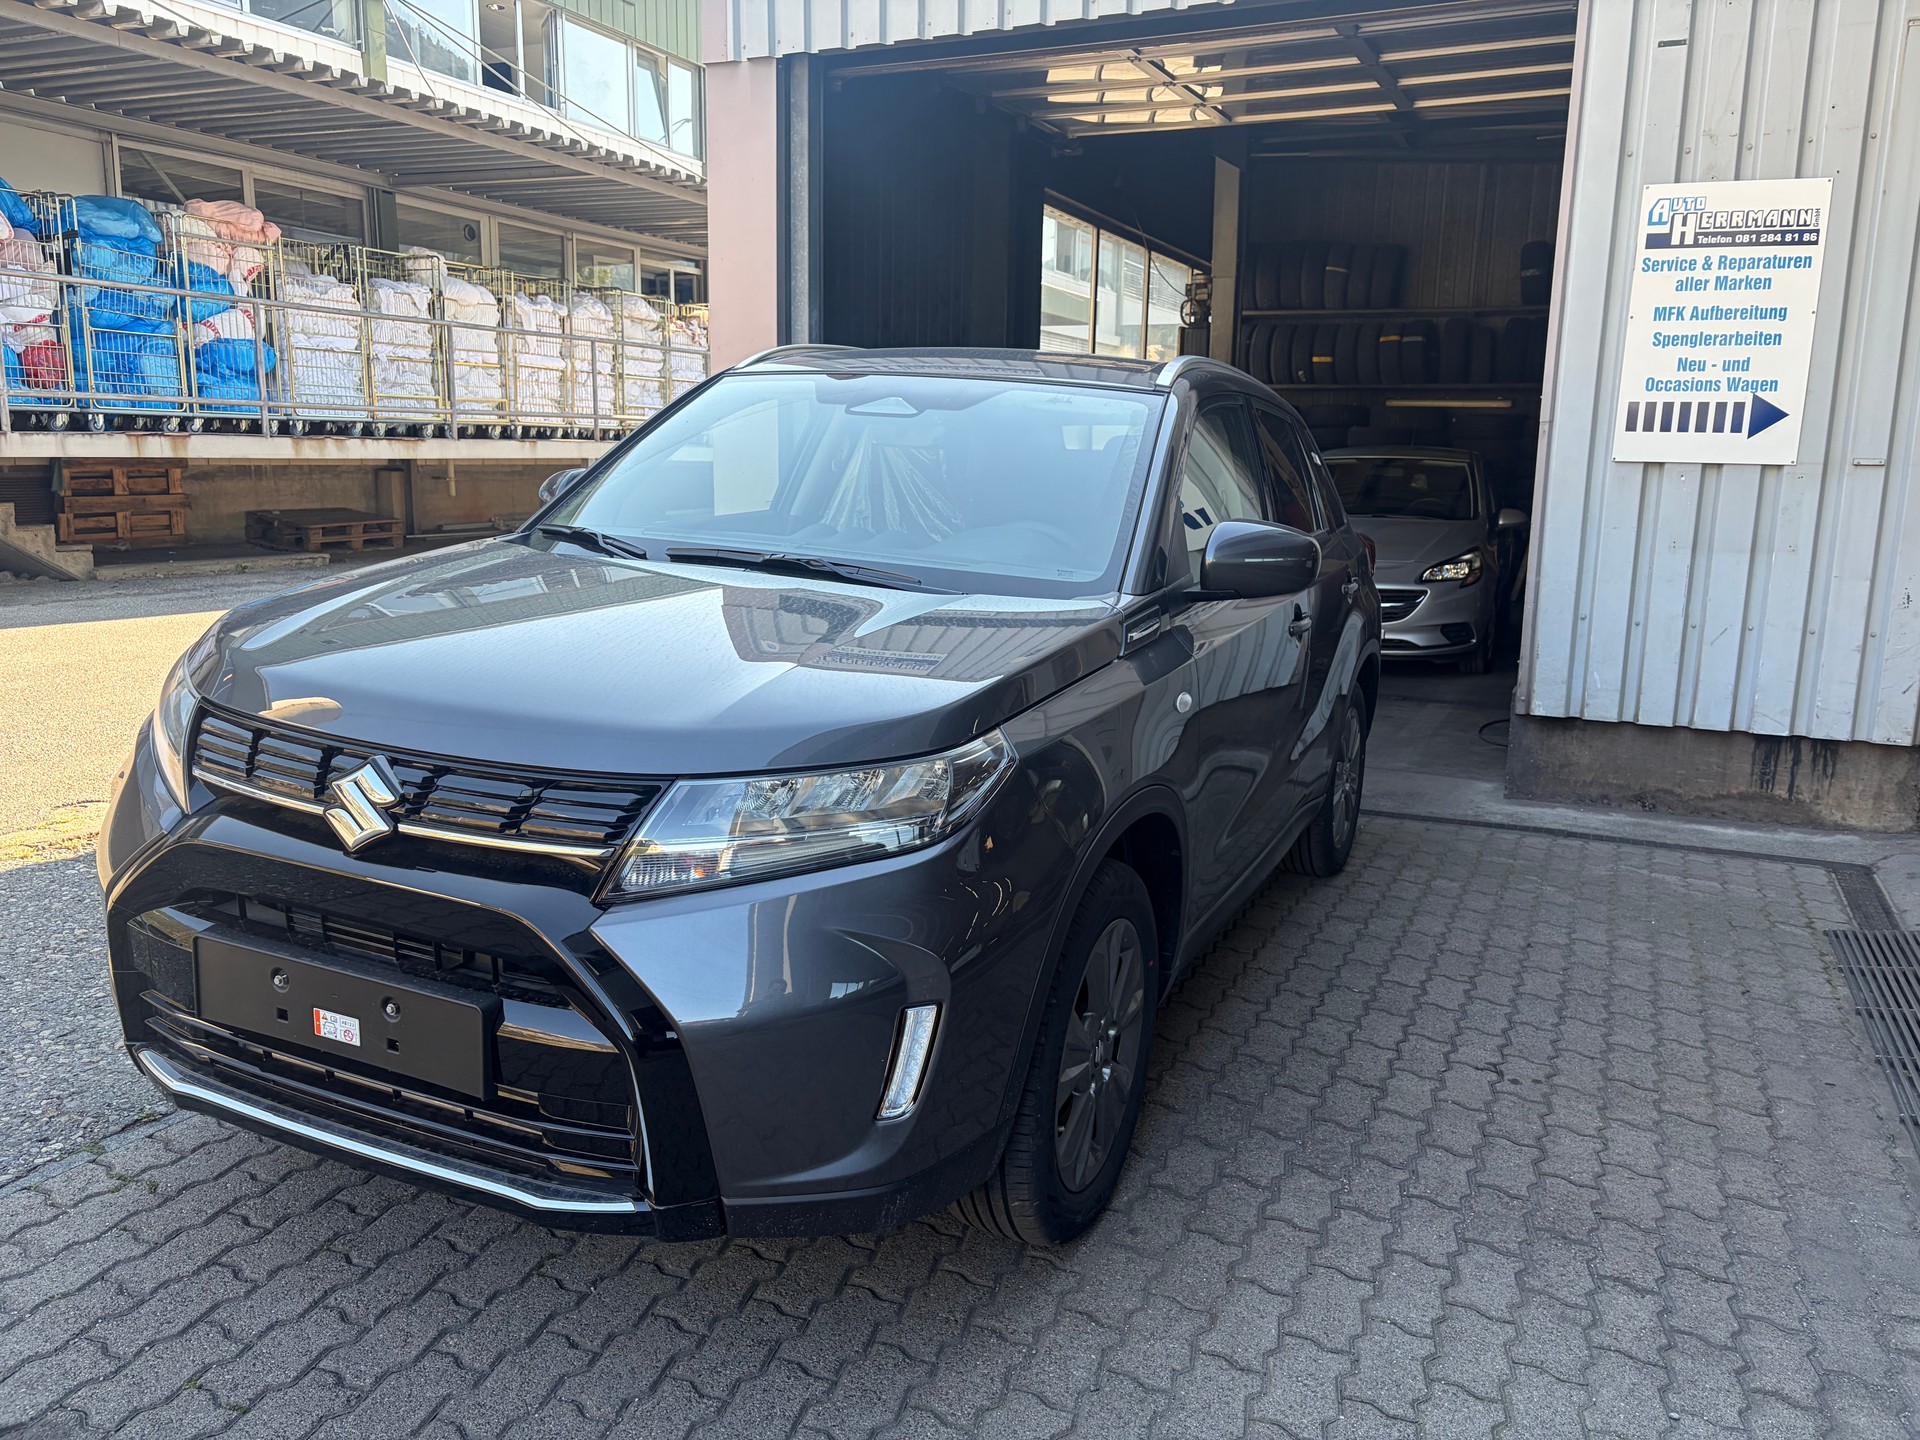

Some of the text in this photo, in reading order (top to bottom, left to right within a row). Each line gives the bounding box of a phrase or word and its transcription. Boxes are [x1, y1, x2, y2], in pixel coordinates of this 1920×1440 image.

[1647, 196, 1707, 226] AUTO
[1813, 208, 1821, 228] GmbH
[1670, 208, 1814, 246] HERRMANN
[1697, 232, 1818, 245] Telefon 081 284 81 86
[1641, 254, 1813, 273] Service & Reparaturen
[1675, 275, 1772, 292] aller Marken
[1653, 305, 1788, 322] MFK Aufbereitung
[1652, 331, 1782, 349] Spenglerarbeiten
[1677, 357, 1707, 372] Neu
[1722, 356, 1751, 372] und
[1645, 376, 1779, 394] Occasions Wagen
